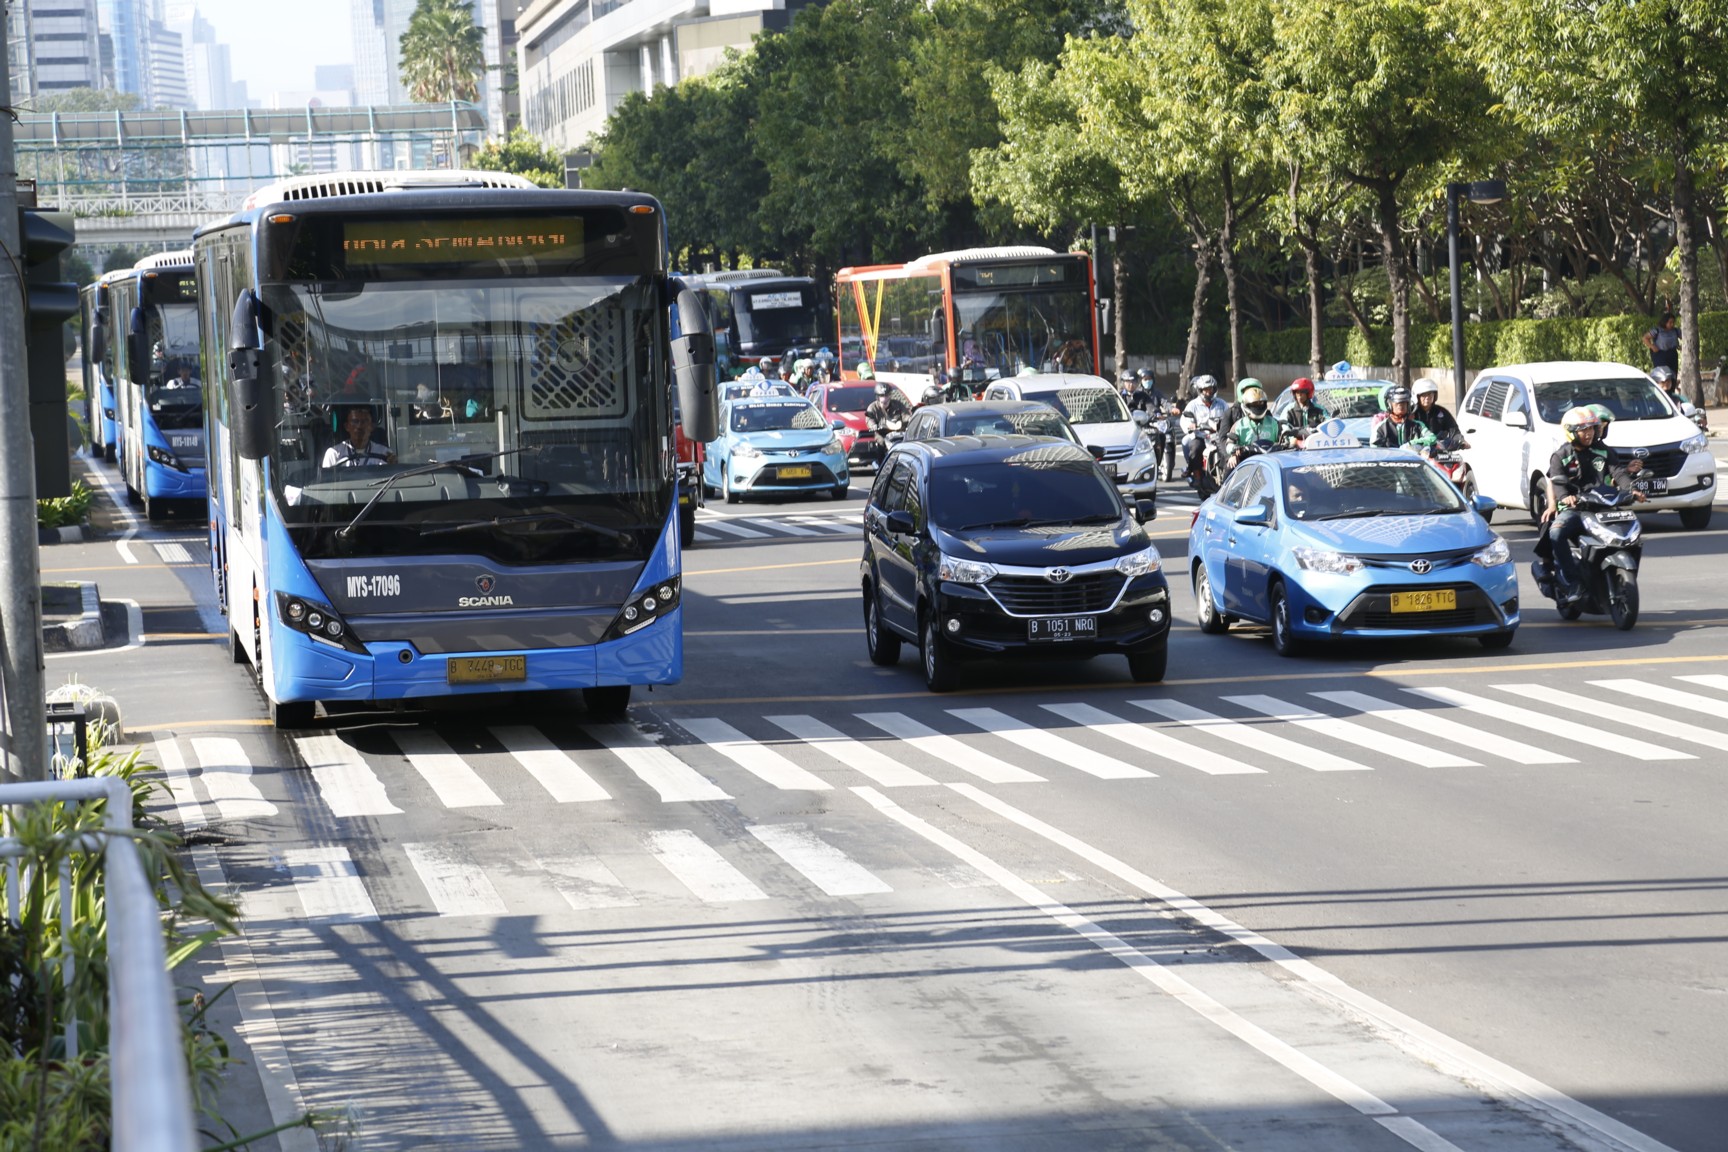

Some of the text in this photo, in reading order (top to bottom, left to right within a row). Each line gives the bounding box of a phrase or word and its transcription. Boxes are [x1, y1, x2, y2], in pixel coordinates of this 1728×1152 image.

[1315, 439, 1351, 447] TAKSI
[347, 574, 400, 598] MYS-17096
[458, 595, 513, 607] SCANIA
[1392, 595, 1400, 607] B
[1406, 593, 1433, 606] 1826
[1435, 591, 1455, 604] TTC
[1031, 618, 1094, 633] B 1051 NRQ
[450, 660, 457, 674] B
[503, 658, 523, 672] TGC
